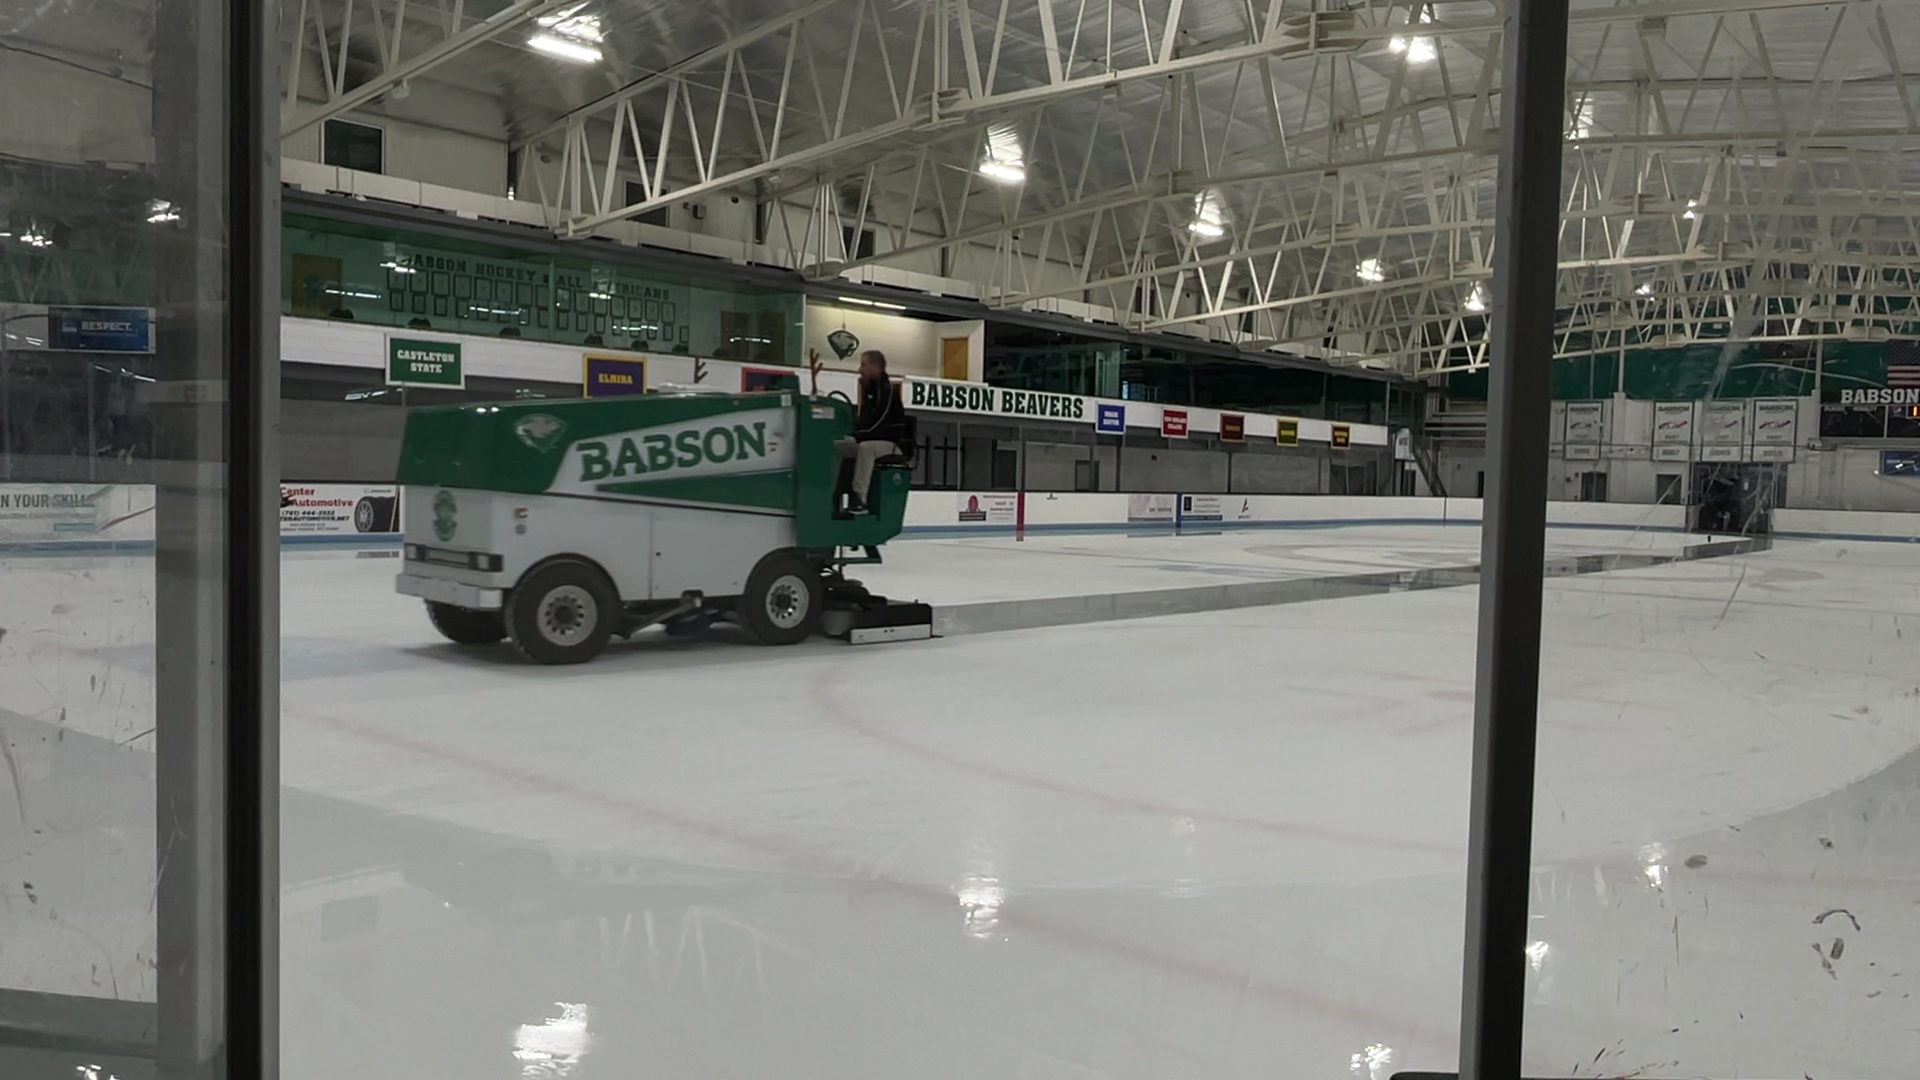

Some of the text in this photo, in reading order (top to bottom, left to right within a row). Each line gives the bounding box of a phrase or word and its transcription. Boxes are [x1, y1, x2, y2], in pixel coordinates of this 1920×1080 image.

[476, 263, 537, 282] HOCKEY
[592, 281, 669, 301] ERICANS
[81, 320, 133, 332] RESPECT.
[397, 349, 455, 364] CASTLETON
[410, 362, 442, 374] STATE
[598, 372, 634, 385] ELMIRA
[912, 381, 1084, 419] BABSON BEAVERS
[1841, 388, 1920, 404] BABSON
[576, 421, 767, 482] BABSON
[14, 494, 49, 508] YOUR
[291, 498, 354, 508] Automotive
